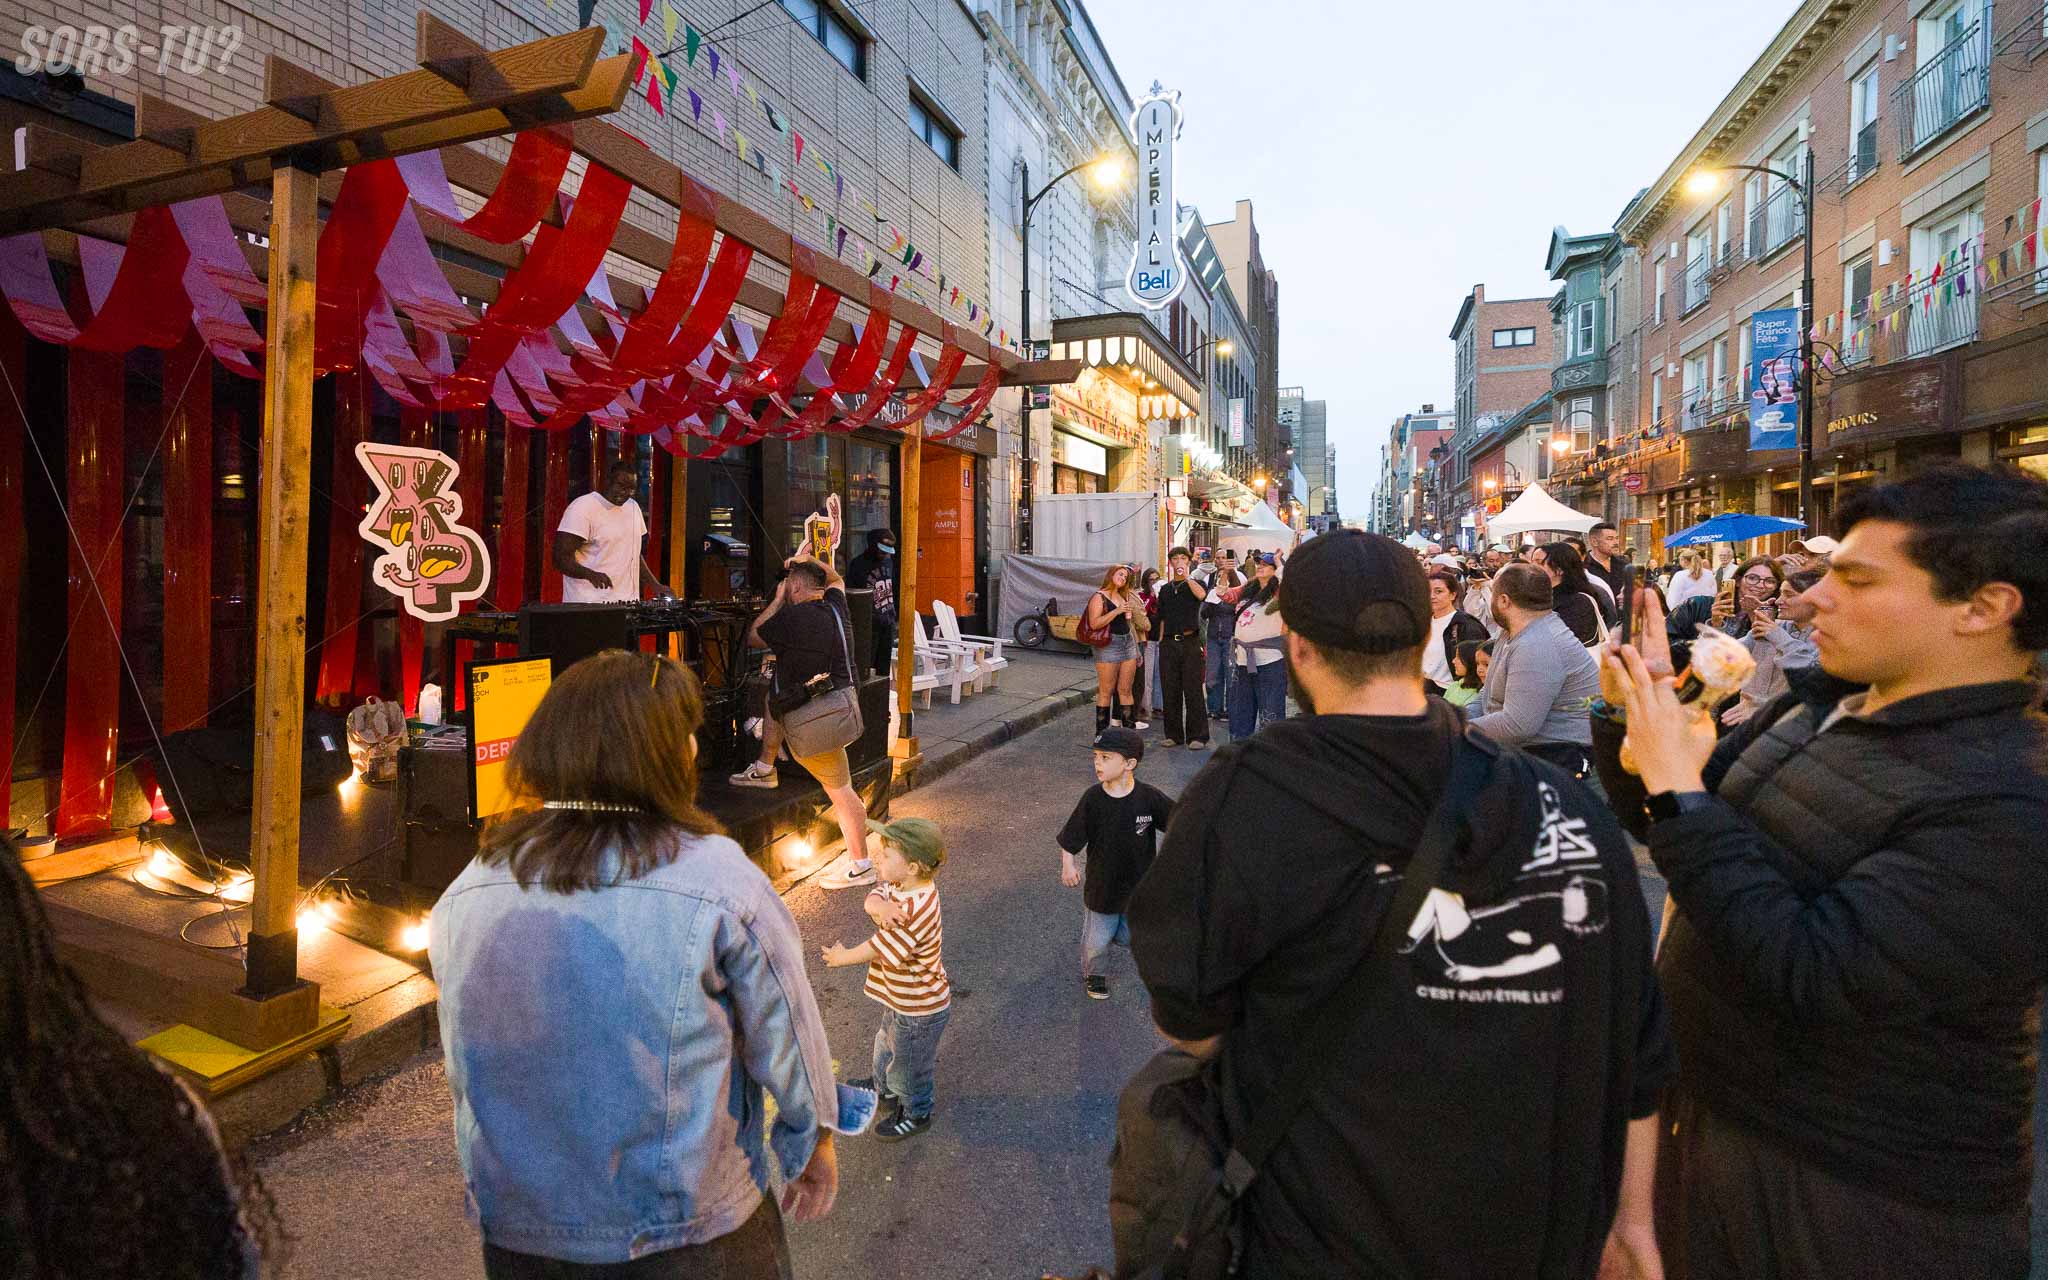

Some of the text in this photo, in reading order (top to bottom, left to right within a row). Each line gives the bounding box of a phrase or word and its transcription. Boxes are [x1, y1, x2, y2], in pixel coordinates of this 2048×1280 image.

[1138, 269, 1171, 291] Bell
[1755, 320, 1787, 330] Super
[1755, 327, 1792, 336] Franco
[1755, 334, 1779, 344] Fête
[703, 541, 711, 551] P
